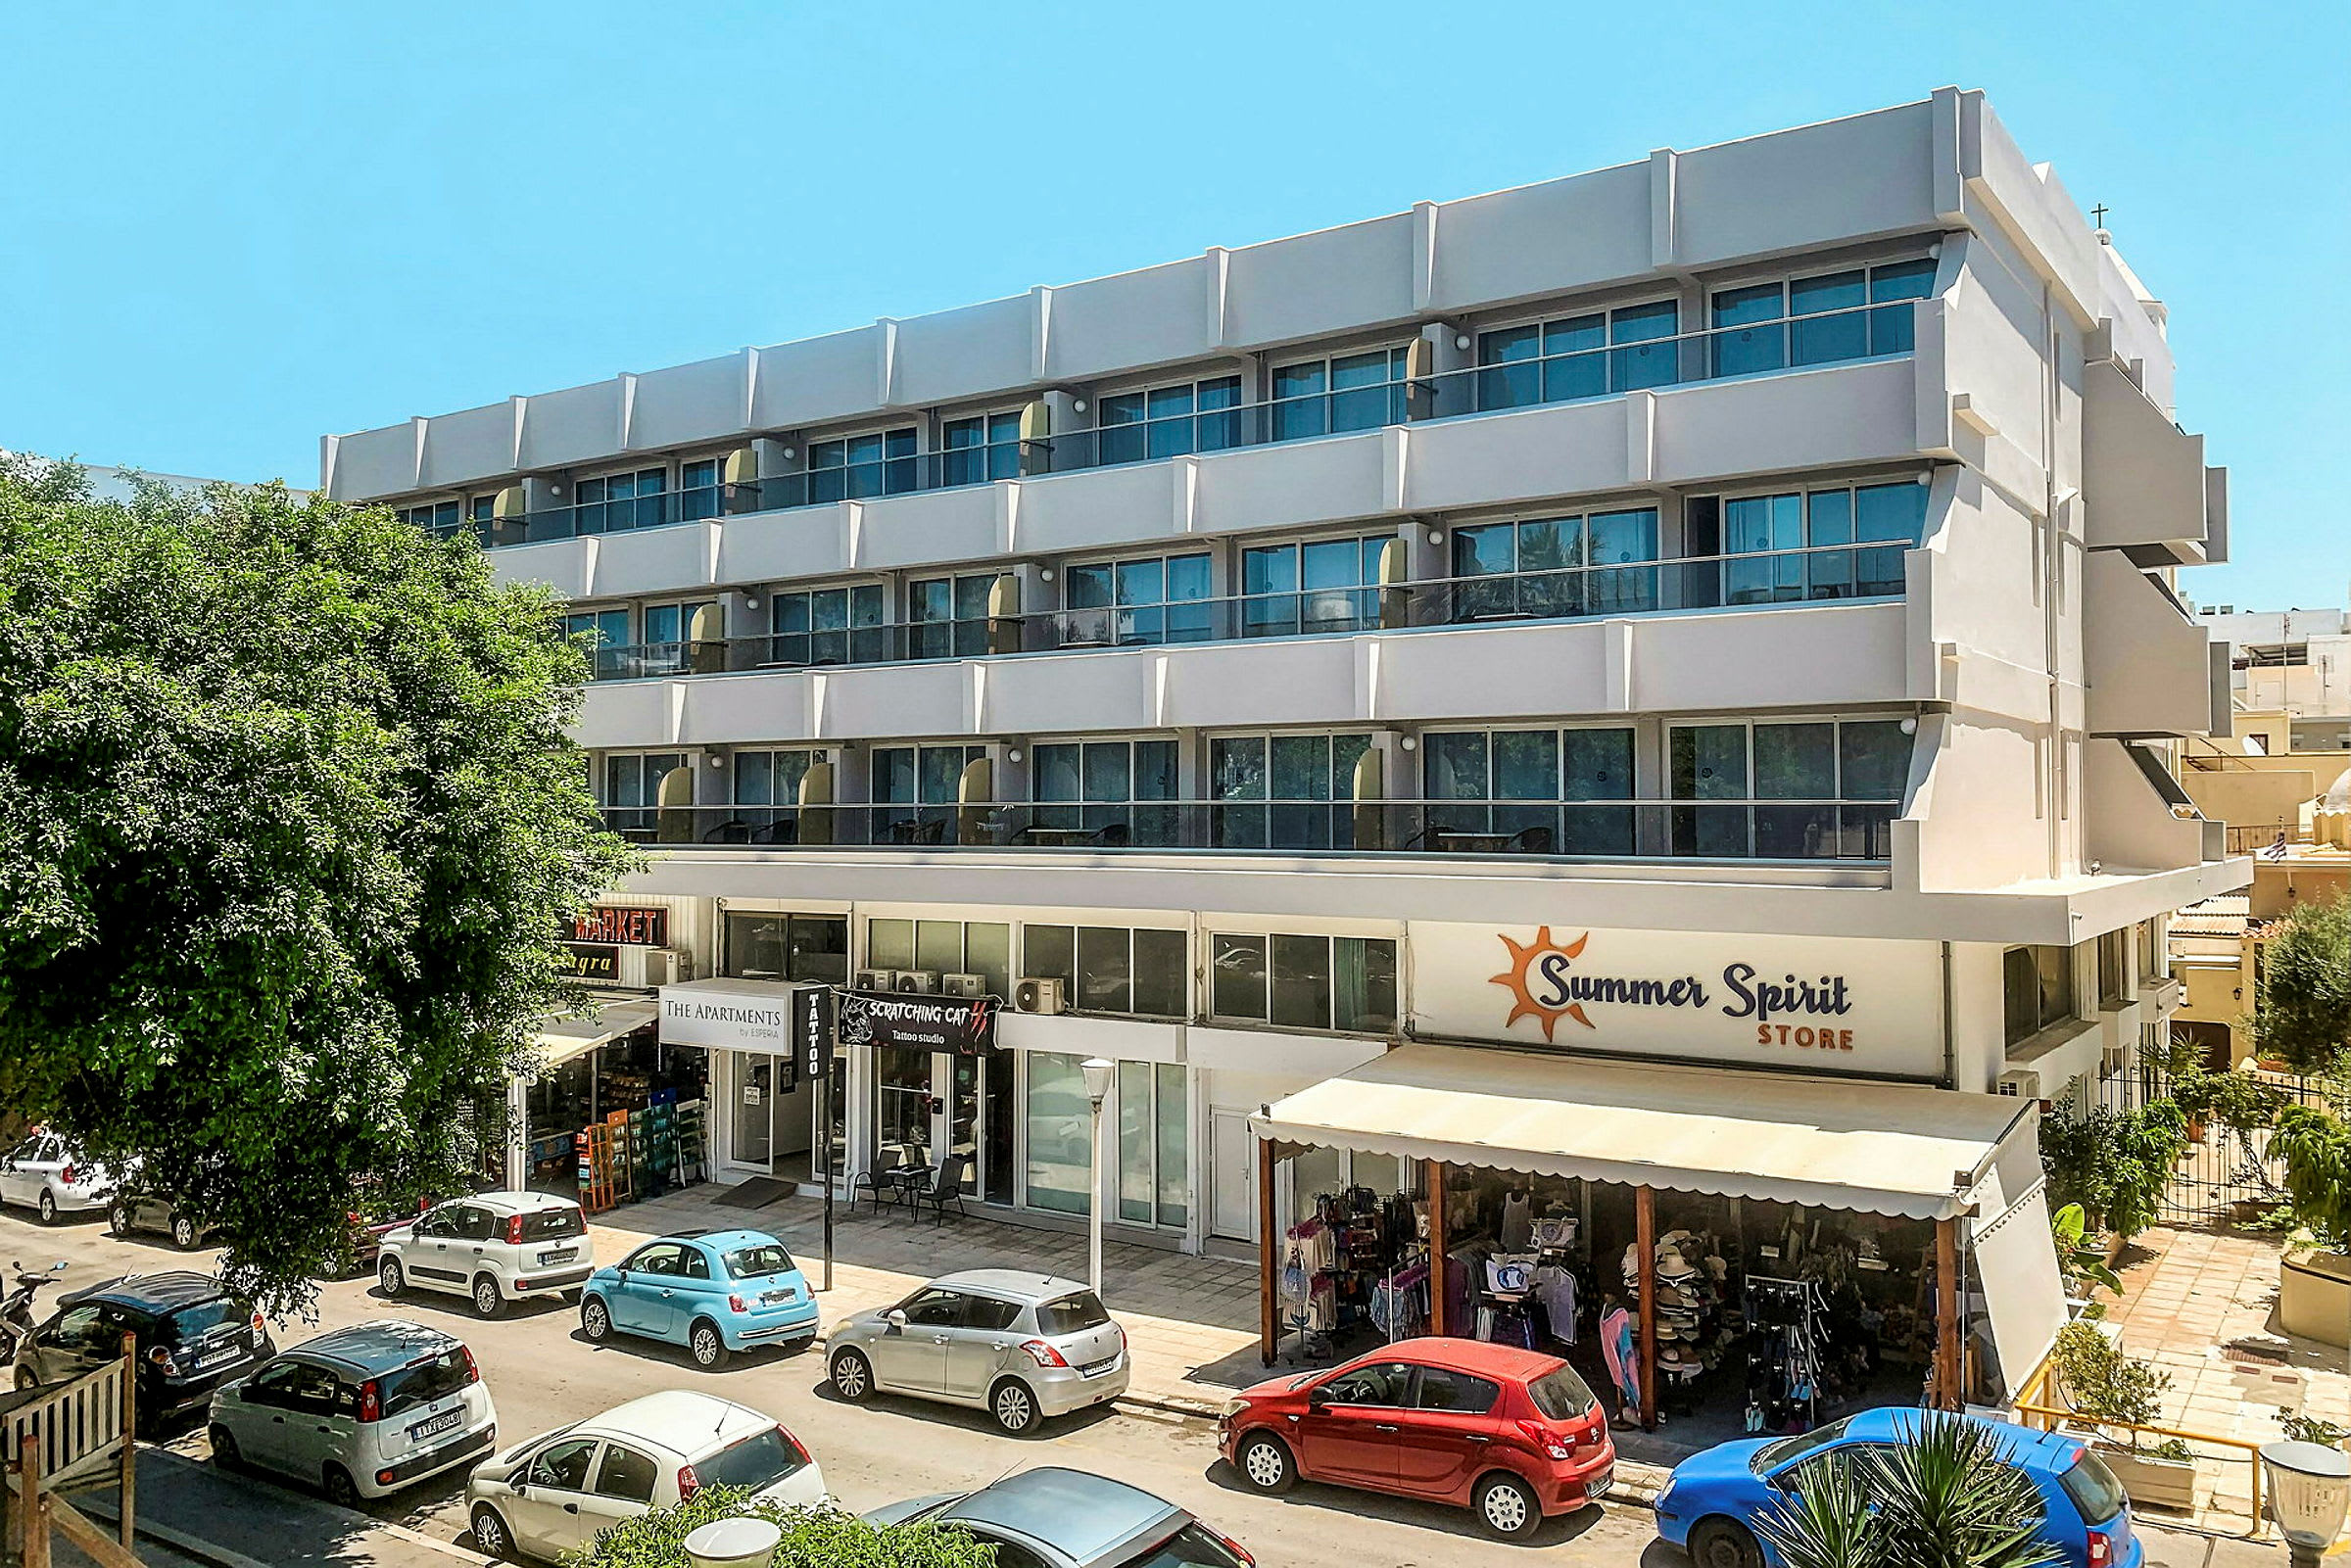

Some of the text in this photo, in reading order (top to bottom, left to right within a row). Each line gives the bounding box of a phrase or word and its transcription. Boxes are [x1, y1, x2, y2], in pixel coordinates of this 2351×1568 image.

[574, 909, 656, 944] MARKET
[1539, 954, 1853, 1022] Summer Spirit
[665, 1000, 782, 1027] THE APARTMENTS
[868, 1001, 970, 1027] SCRATCHING CAT
[808, 992, 820, 1075] TATTOO
[891, 1029, 945, 1045] Tattoo studio
[1757, 1023, 1854, 1051] STORE
